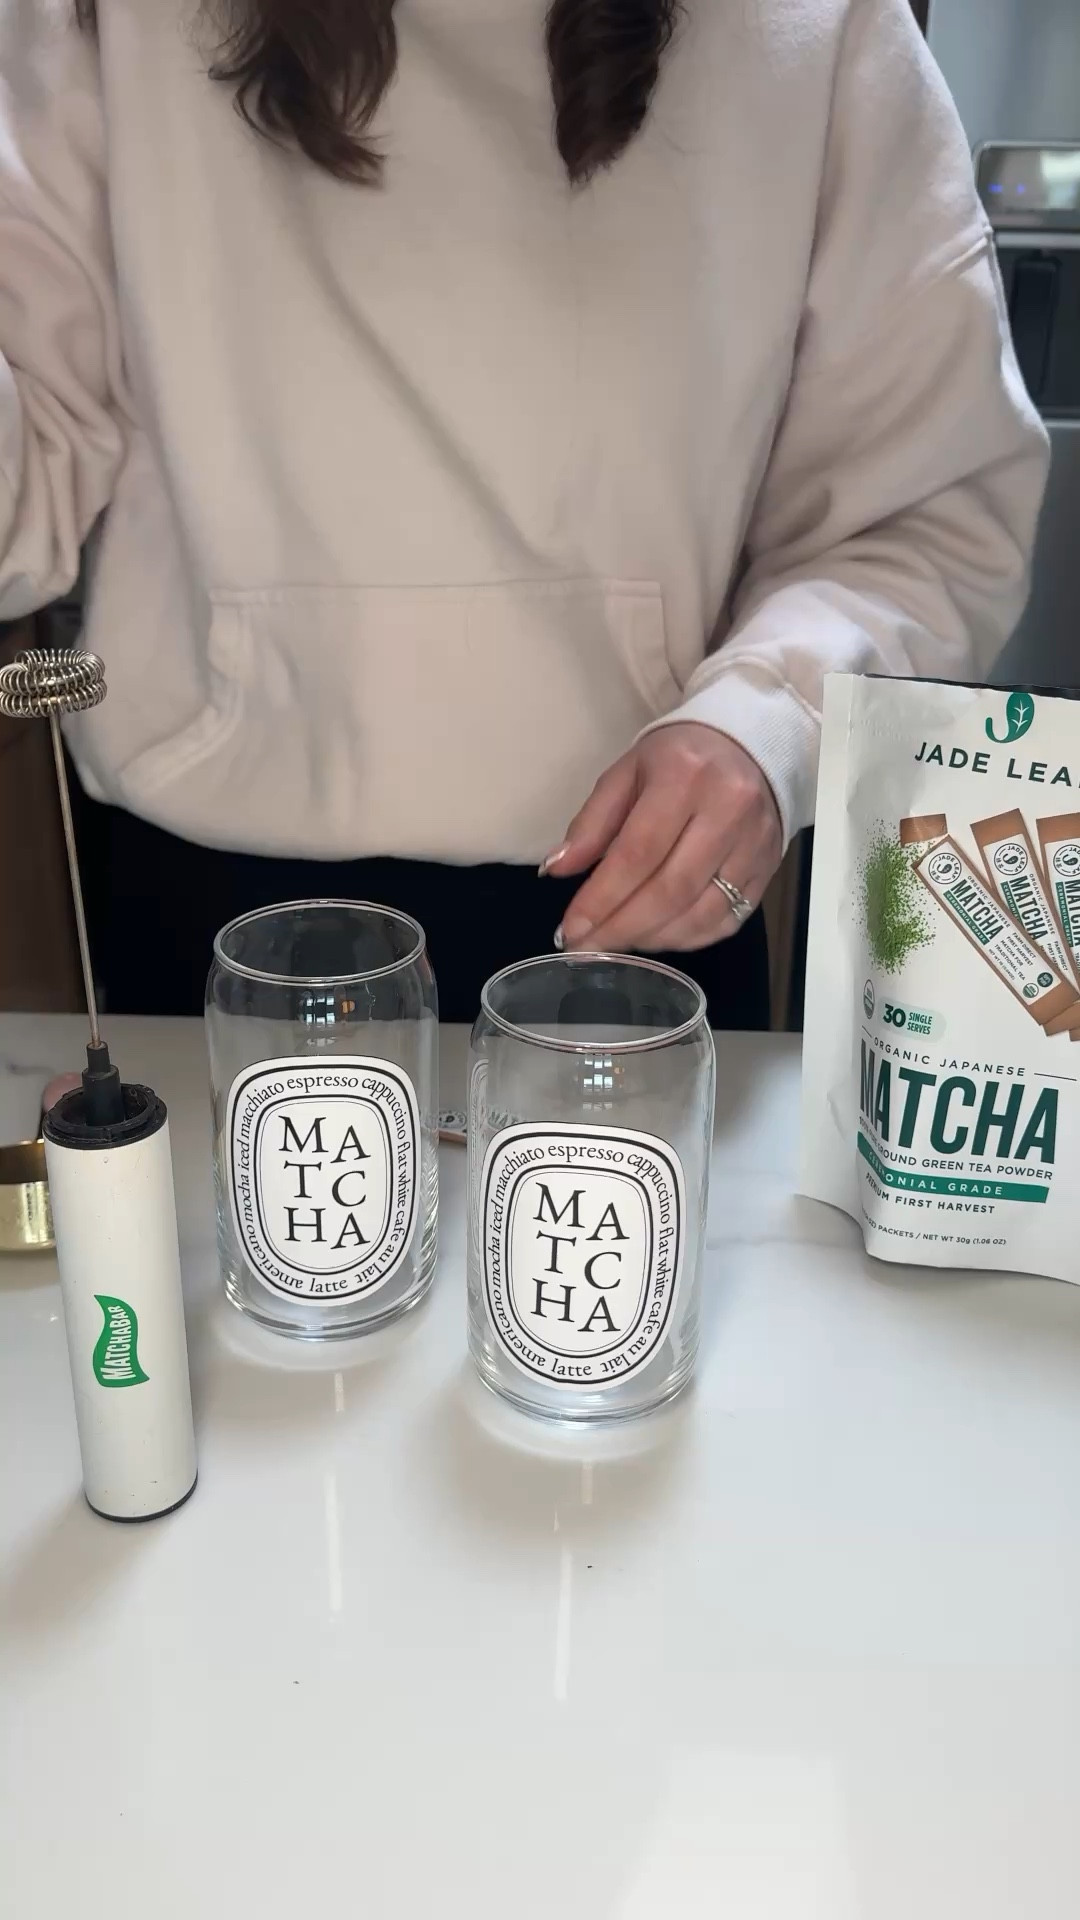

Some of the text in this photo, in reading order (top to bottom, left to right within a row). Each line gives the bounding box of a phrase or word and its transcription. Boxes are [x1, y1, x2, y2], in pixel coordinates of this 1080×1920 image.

[915, 742, 1080, 789] JADE LEA
[950, 879, 1004, 940] MATCHA
[967, 875, 1011, 929] ORGANIC JAPANESE
[1009, 875, 1049, 941] MATCHA
[1029, 873, 1056, 935] ORGANIC JAPANESE
[883, 1003, 906, 1028] 30
[907, 1022, 931, 1035] SERVES
[908, 1012, 933, 1026] SINGLE
[874, 1037, 1026, 1077] ORGANIC JAPANESE
[860, 1038, 1060, 1165] MATCHA
[547, 1145, 625, 1163] espresso
[922, 1159, 964, 1171] GREEN
[969, 1163, 992, 1174] TEA
[997, 1165, 1053, 1181] POWDER
[237, 1075, 412, 1293] macchiato espresso cappuccino flat white cafe au lait latte americano mocha iced
[496, 1146, 545, 1203] macchiato
[627, 1152, 674, 1224] cappuccino
[948, 1182, 1003, 1196] GRADE
[489, 1198, 504, 1236] iced
[895, 1195, 932, 1208] FIRST
[938, 1201, 995, 1214] HARVEST
[658, 1226, 675, 1257] flat
[878, 1225, 914, 1239] PACKETS
[922, 1233, 938, 1241] NET
[955, 1237, 971, 1245] 30g
[487, 1237, 502, 1287] mocha
[654, 1257, 672, 1300] white
[493, 1288, 546, 1368] americano
[645, 1301, 661, 1335] cafe
[100, 1305, 136, 1380] MATCHABAR
[627, 1336, 648, 1356] au
[551, 1358, 592, 1377] latte
[600, 1353, 632, 1374] lait
